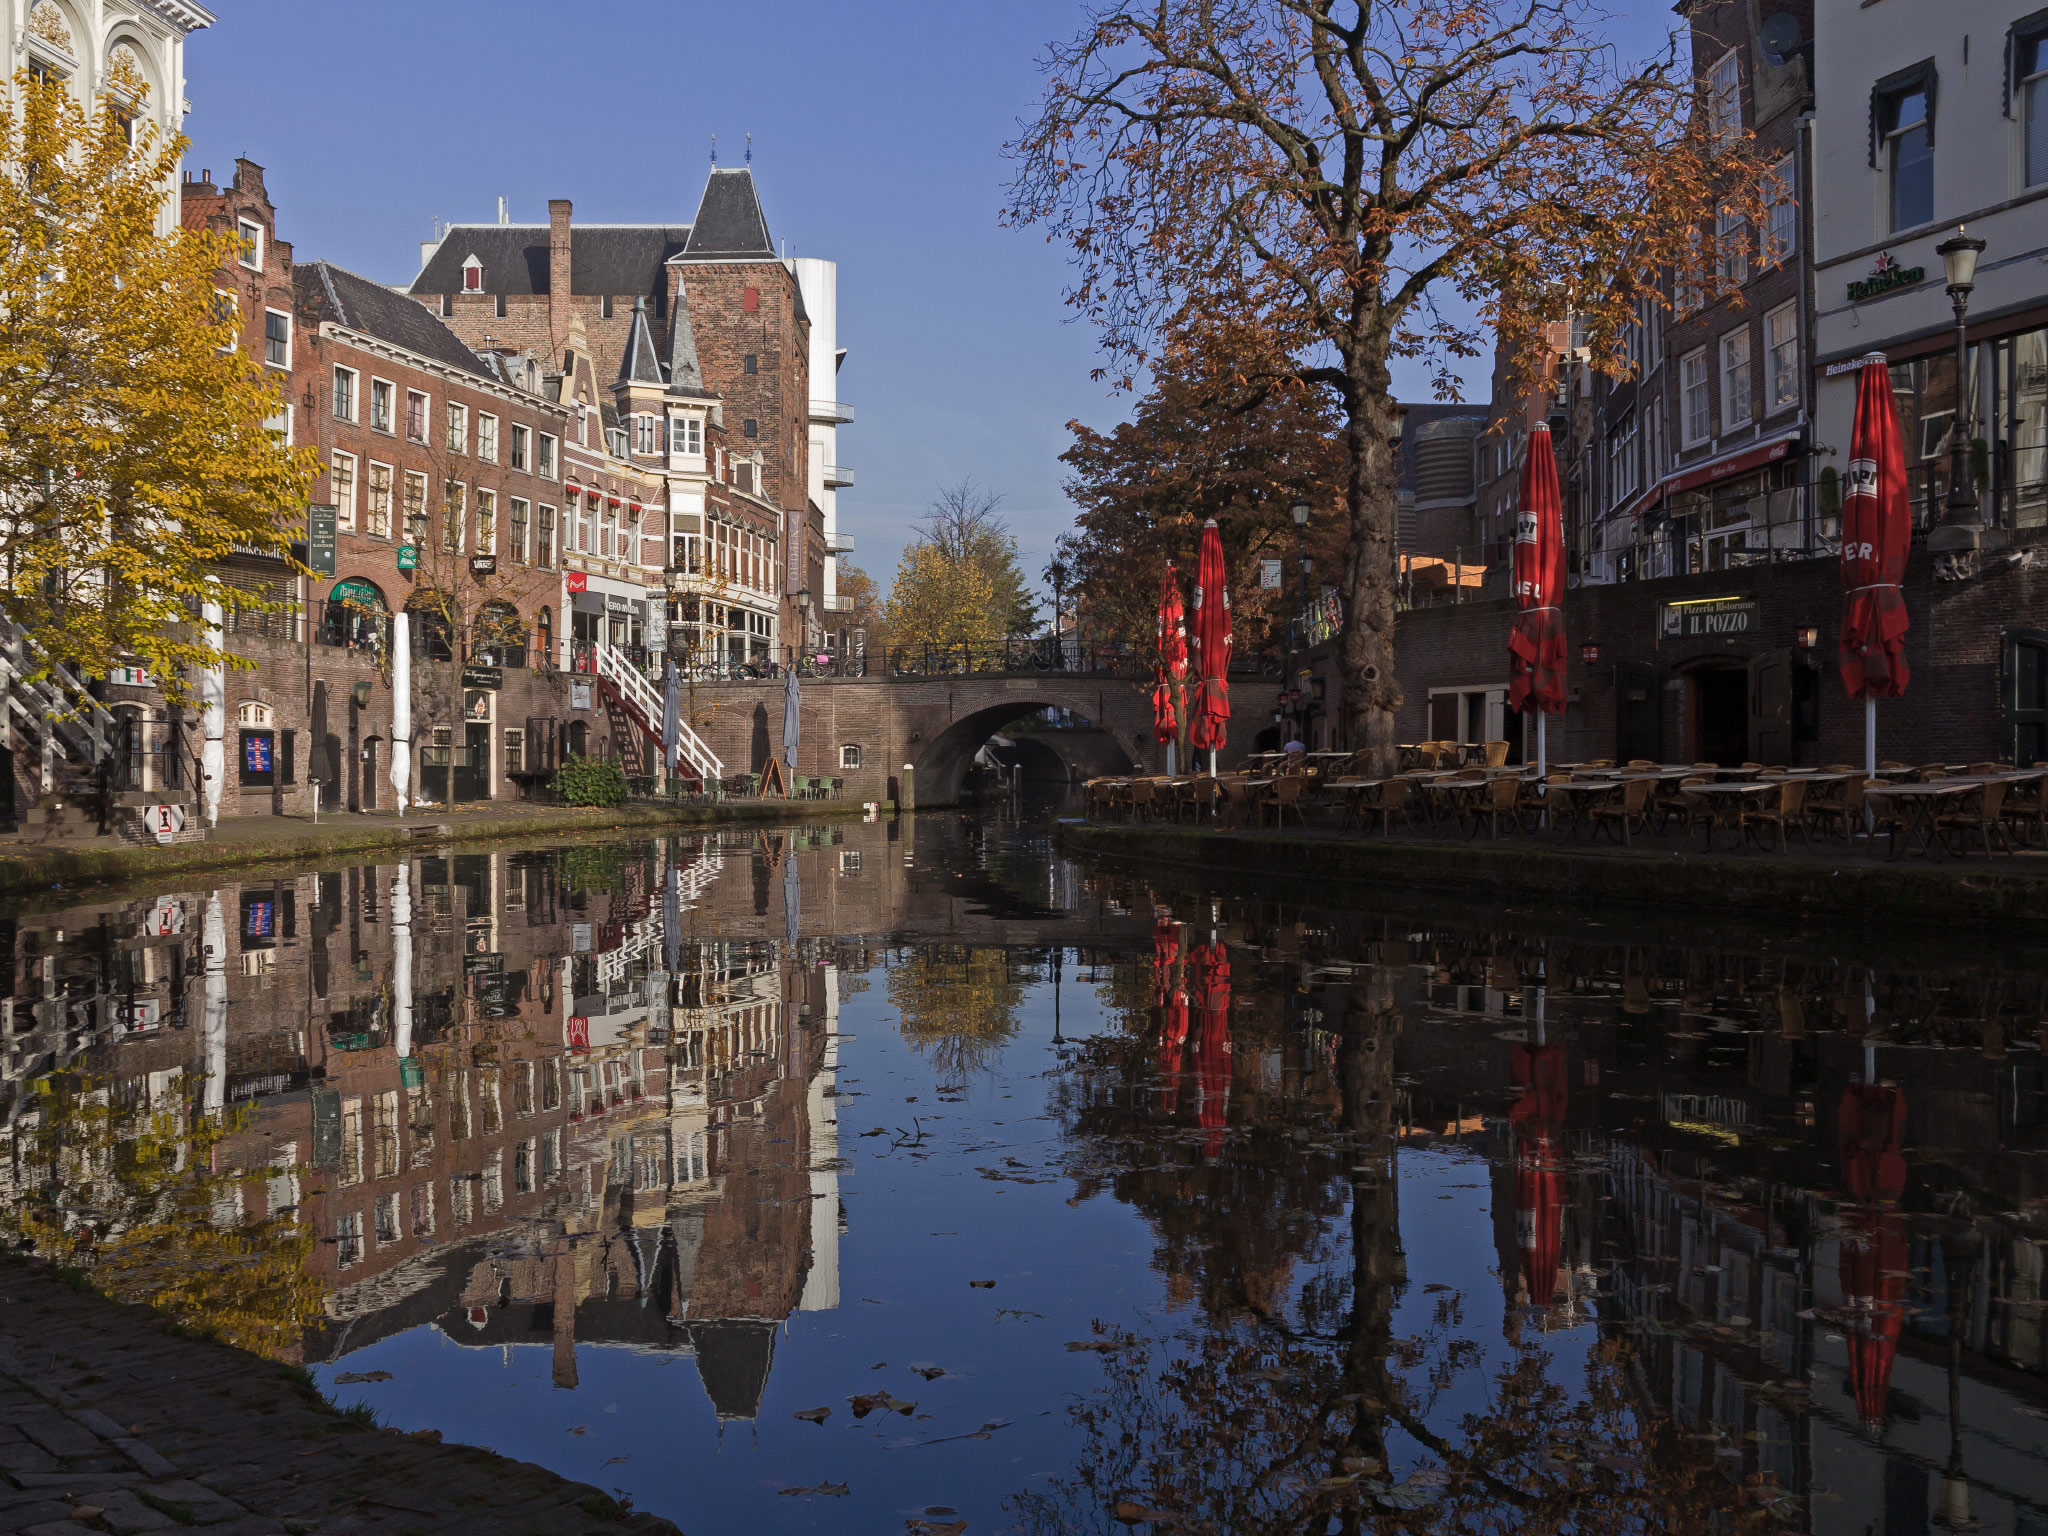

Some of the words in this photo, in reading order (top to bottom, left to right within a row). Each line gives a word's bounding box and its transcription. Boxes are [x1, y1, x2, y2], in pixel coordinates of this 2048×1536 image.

[1847, 266, 1924, 301] Heineken
[1826, 359, 1864, 376] Heineke
[1684, 604, 1714, 615] Pizzeria
[1716, 601, 1755, 612] Ristorante
[1690, 616, 1703, 634] IL
[1705, 611, 1748, 633] POZZO
